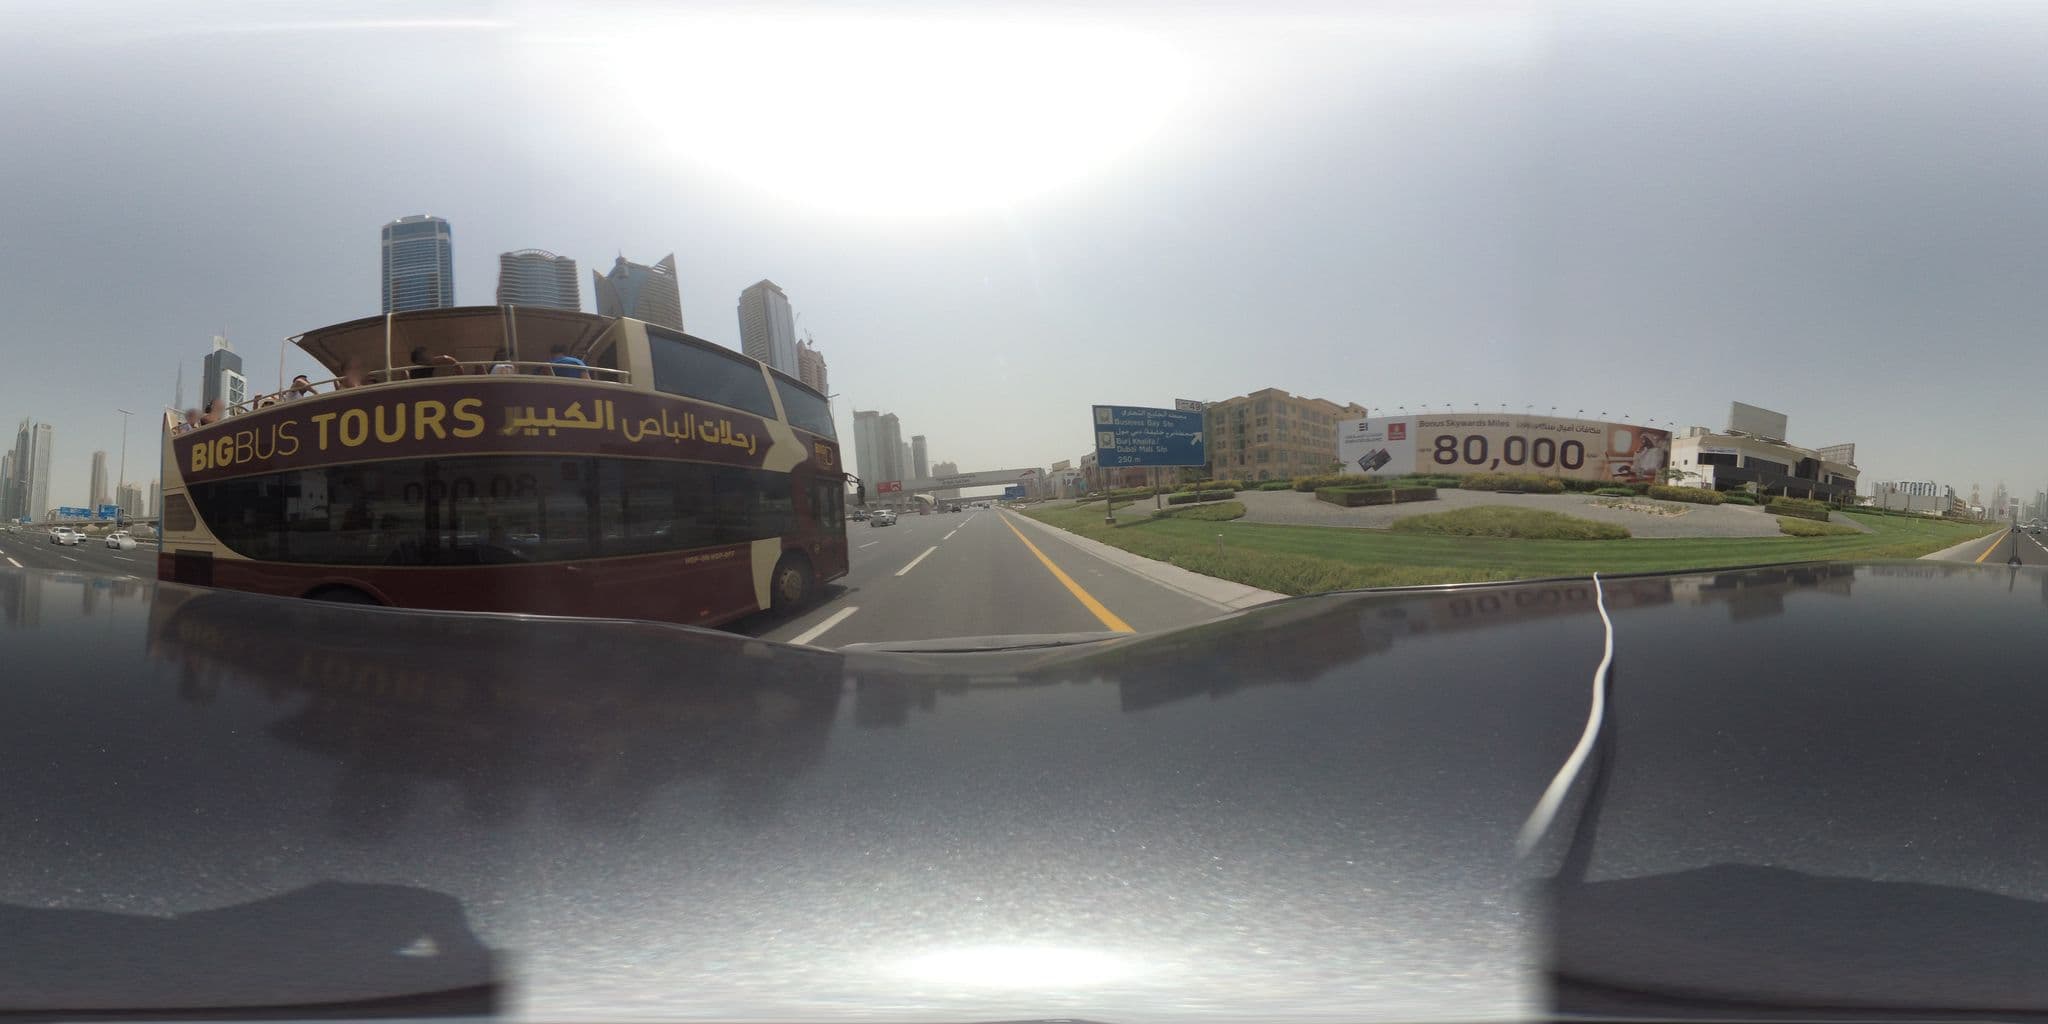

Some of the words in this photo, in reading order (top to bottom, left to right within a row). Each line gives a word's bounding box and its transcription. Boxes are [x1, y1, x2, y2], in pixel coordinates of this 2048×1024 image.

[311, 398, 485, 451] TOURS
[499, 399, 614, 436] الكبير
[621, 410, 696, 443] الباص
[697, 415, 757, 456] رحلات
[1418, 420, 1444, 428] Bonus
[1446, 419, 1487, 428] Skywards
[1488, 419, 1510, 428] Miles
[1118, 456, 1132, 464] 250
[1433, 434, 1585, 471] 80,000
